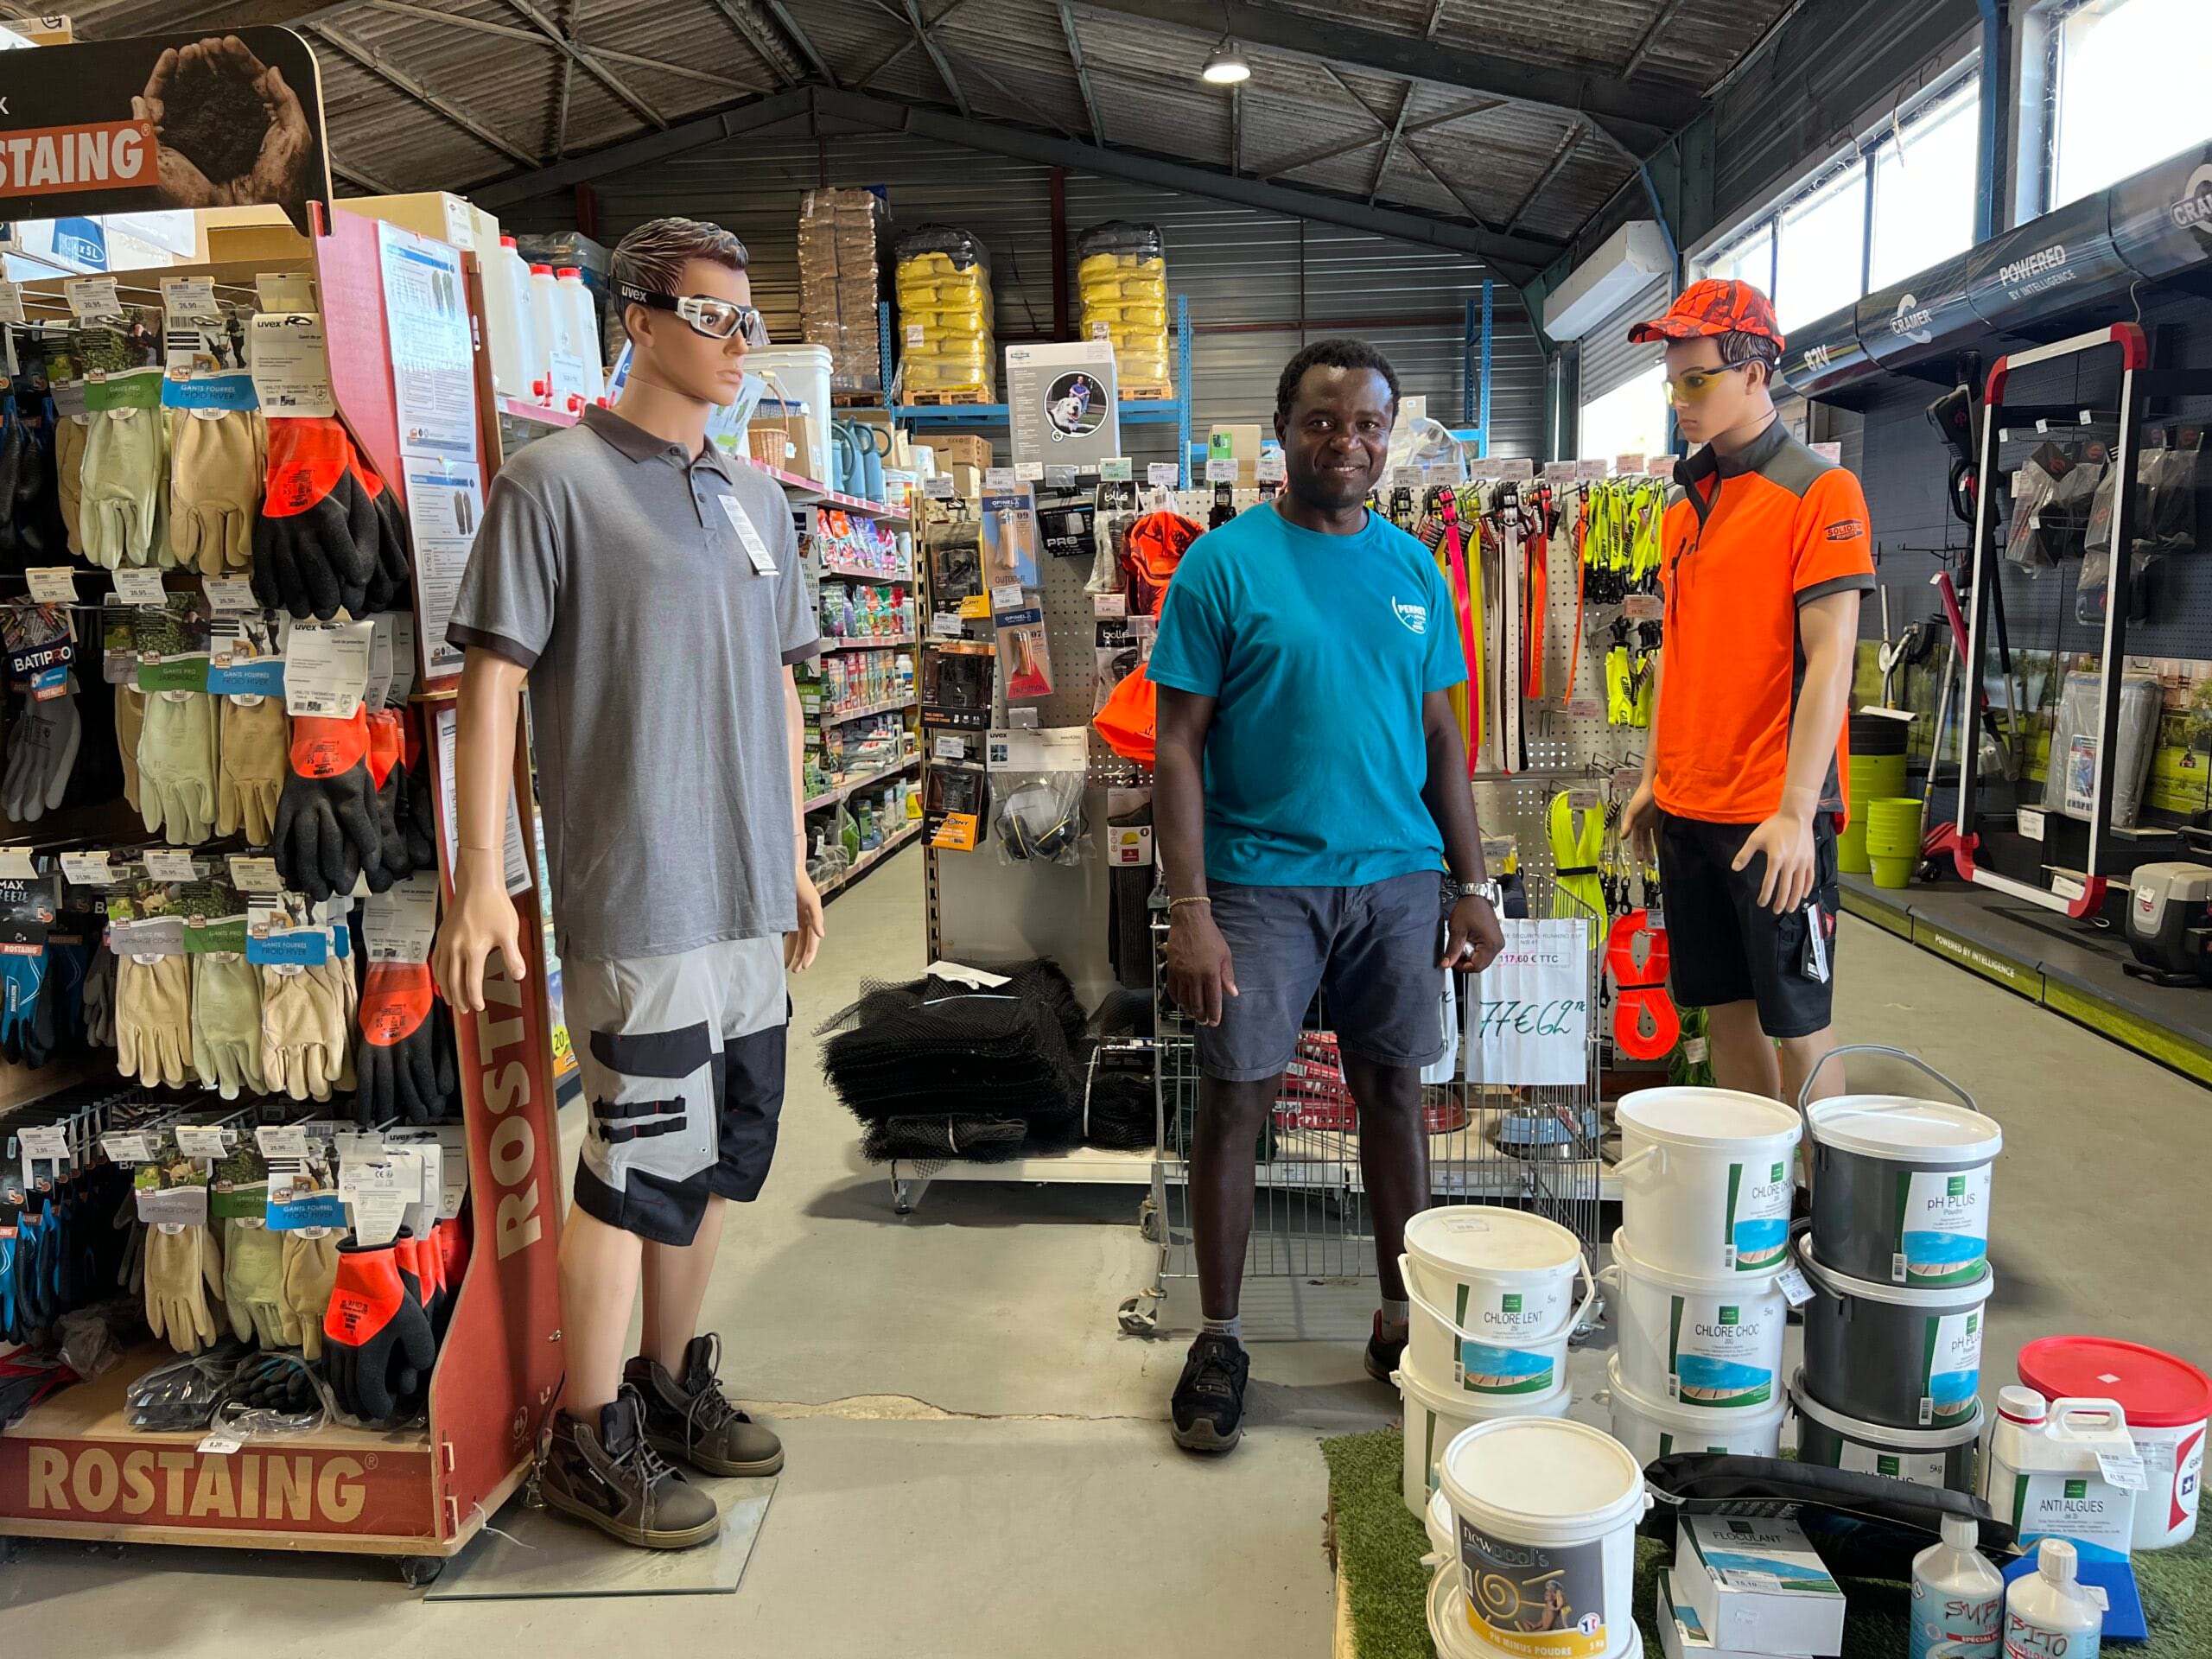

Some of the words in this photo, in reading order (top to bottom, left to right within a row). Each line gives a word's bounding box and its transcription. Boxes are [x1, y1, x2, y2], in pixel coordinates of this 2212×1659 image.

[1999, 244, 2067, 286] POWERED
[621, 285, 647, 302] uvex
[2008, 289, 2021, 302] BY
[2021, 270, 2077, 296] INTELLIGENCE
[1891, 309, 1930, 334] CRAMER
[1803, 344, 1831, 372] 82V
[13, 645, 71, 672] BATIPRO
[4, 944, 38, 954] ROSTAING
[1936, 934, 1962, 953] POWERED
[1963, 946, 1971, 957] BY
[1972, 950, 2015, 978] INTELLIGENCE
[1499, 955, 1529, 963] 117,60
[554, 1031, 564, 1051] 20
[477, 950, 541, 1260] ROSTA
[1752, 1184, 1780, 1199] CHLORE
[1928, 1197, 1944, 1211] pH
[1948, 1193, 1975, 1208] PLUS
[1484, 1312, 1521, 1325] CHLORE
[1522, 1310, 1542, 1323] LENT
[1695, 1324, 1734, 1338] CHLORE
[1736, 1323, 1759, 1336] CHOC
[1951, 1337, 1964, 1353] pH
[1929, 1465, 1942, 1474] 5kg
[29, 1446, 366, 1523] ROSTAING
[2040, 1499, 2062, 1512] ANTI
[2064, 1499, 2104, 1513] ALGUES
[1713, 1531, 1783, 1543] FLOCULANT
[1503, 1637, 1531, 1654] MINUS
[1535, 1646, 1572, 1656] POUDRE
